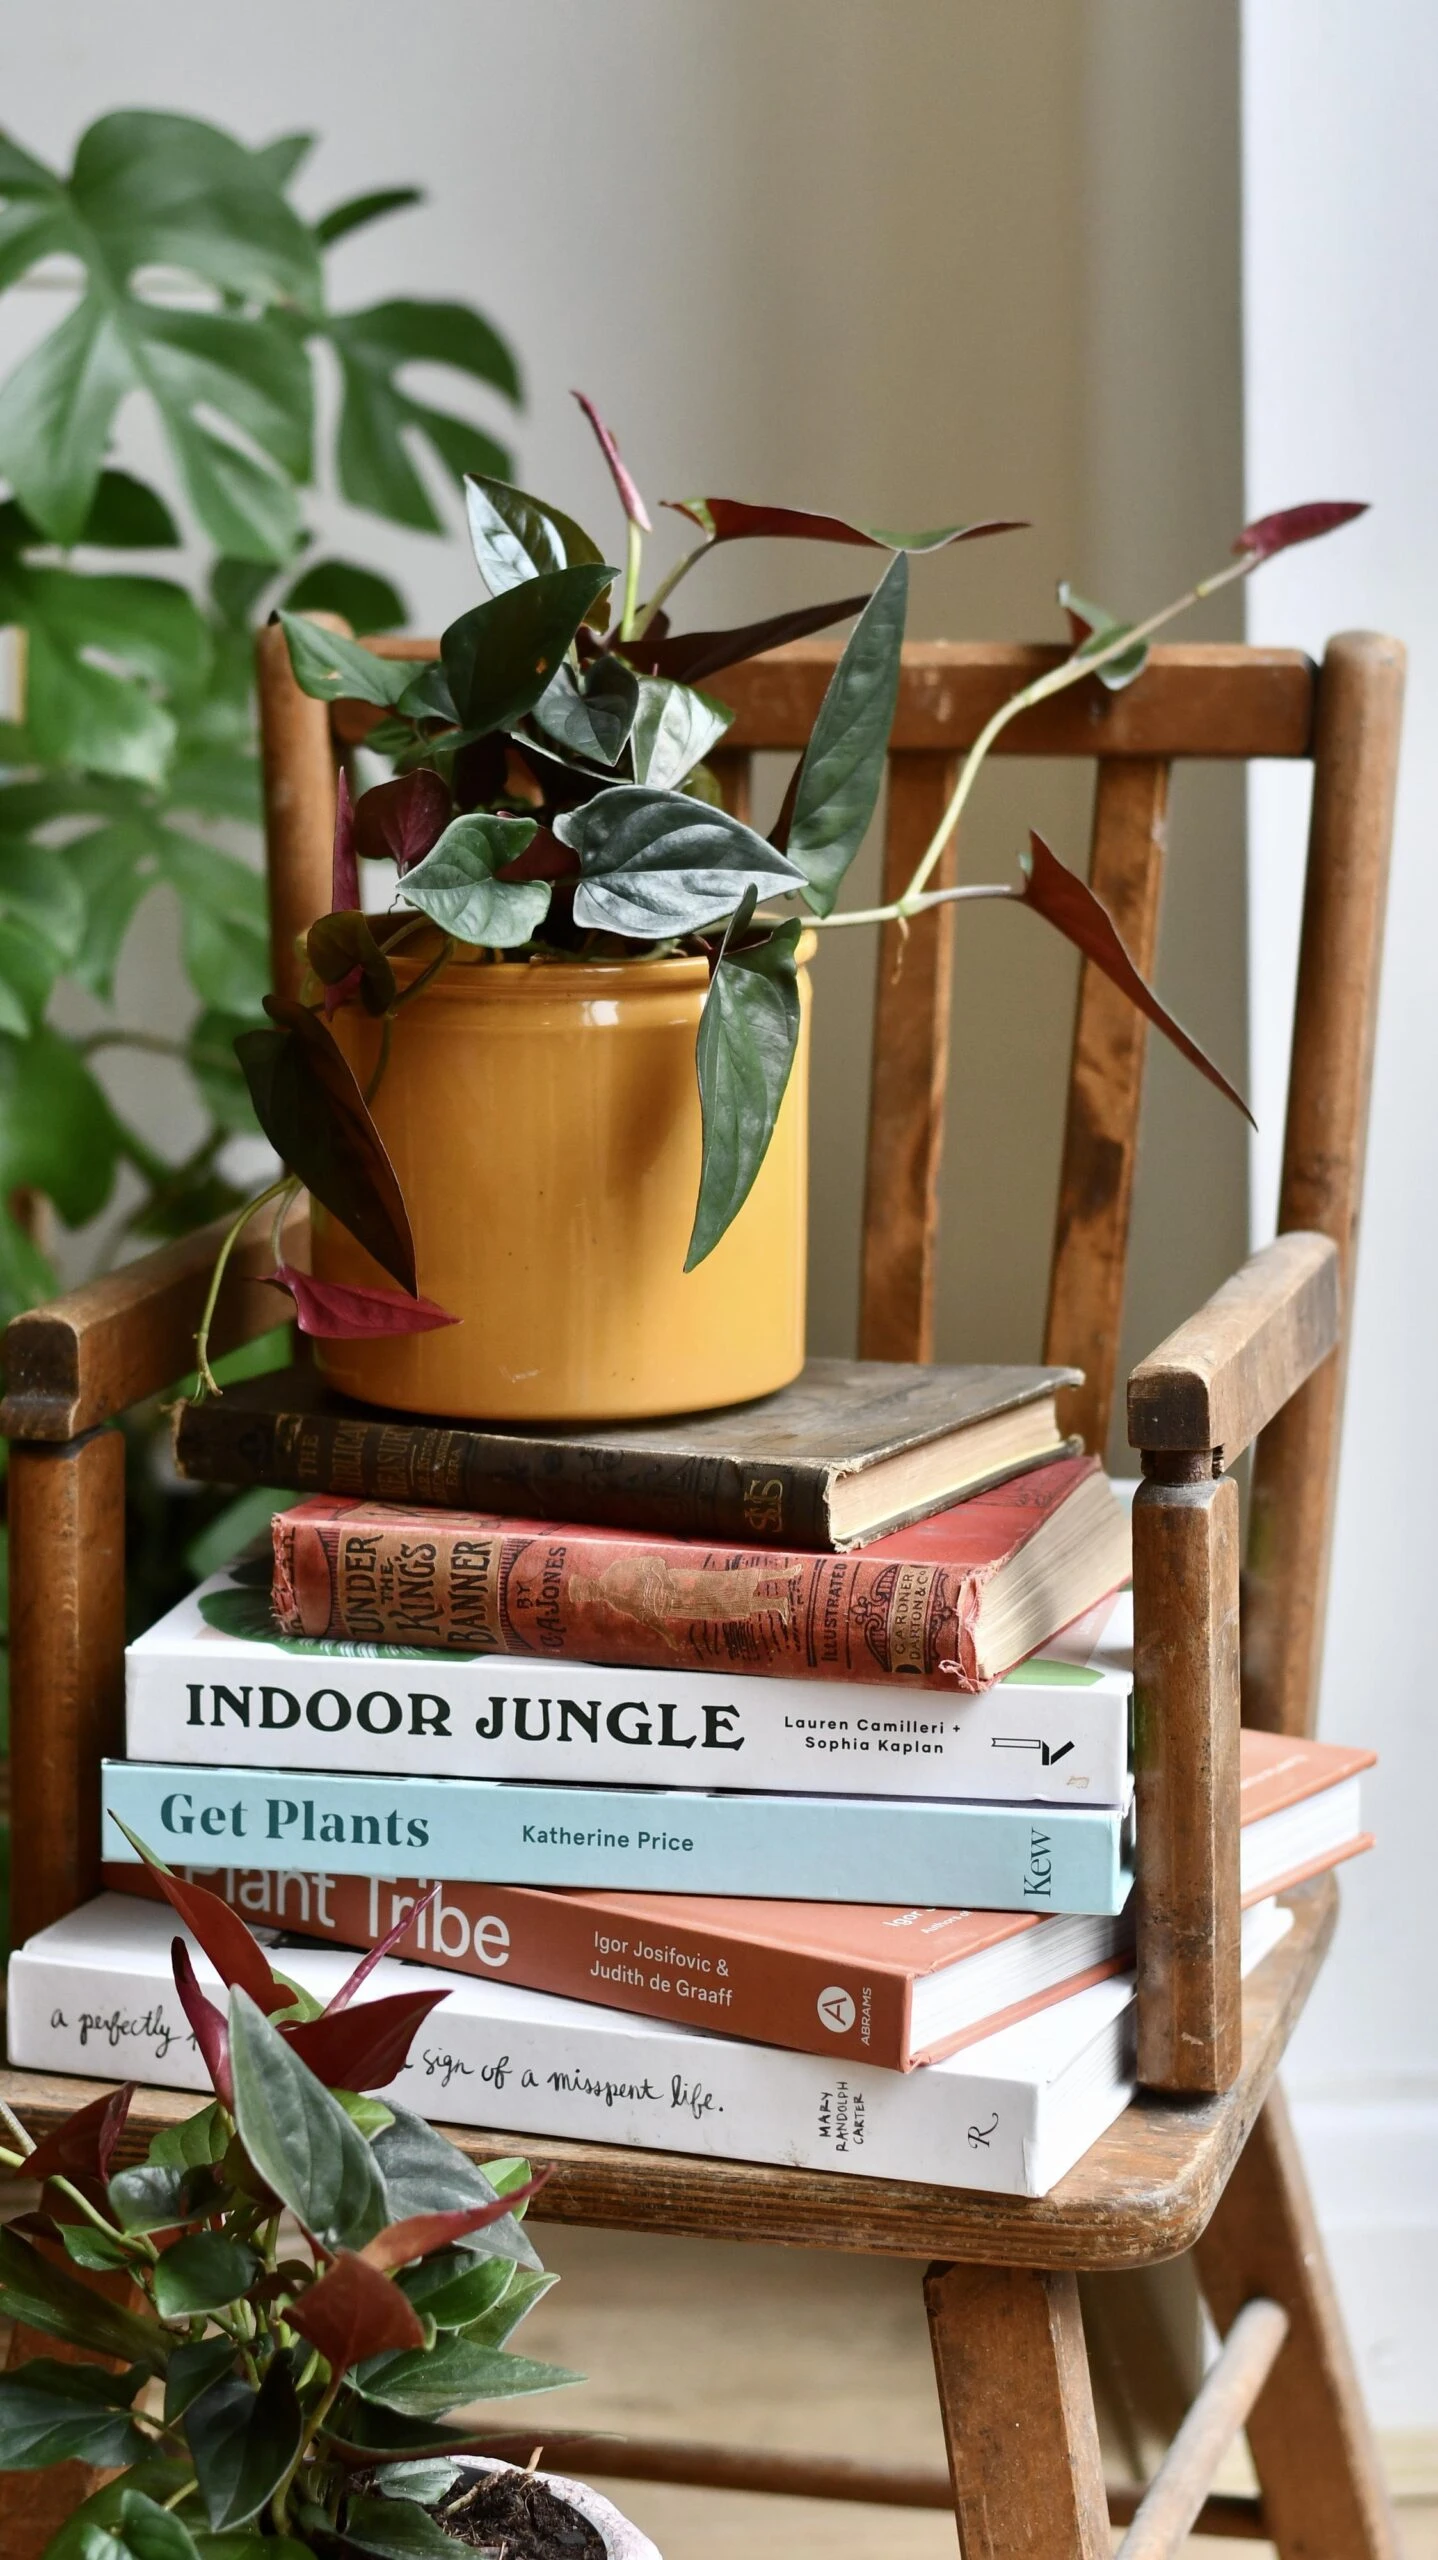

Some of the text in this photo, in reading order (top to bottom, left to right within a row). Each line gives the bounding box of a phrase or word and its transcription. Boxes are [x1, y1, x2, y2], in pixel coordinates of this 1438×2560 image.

[345, 1533, 384, 1638] UNDER
[379, 1557, 394, 1605] THE
[388, 1543, 445, 1635] KING'S
[448, 1539, 498, 1645] BANNER
[516, 1580, 534, 1610] BY
[821, 1562, 848, 1662] ILLUSTRATED
[909, 1601, 926, 1661] DARTON
[186, 1684, 745, 1751] INDOOR JUNGLE
[784, 1716, 961, 1734] Lauren Camilleri +
[805, 1736, 944, 1755] Sophia Kaplan
[160, 1793, 430, 1847] Get Plants
[522, 1824, 694, 1852] Katherine Price
[1023, 1826, 1051, 1898] Kew
[358, 1875, 511, 1968] Tribe
[590, 1960, 733, 2006] Judith de Graaff
[594, 1930, 729, 1977] Igor Josifovic &
[861, 1986, 873, 2046] ABRAMS
[51, 2008, 68, 2028] a
[79, 2004, 181, 2059] perfectly
[422, 2047, 474, 2087] sign
[481, 2055, 512, 2089] of
[521, 2068, 539, 2087] a
[547, 2068, 664, 2107] misspent
[671, 2073, 724, 2119] life.
[818, 2091, 833, 2137] MARY
[835, 2081, 850, 2152] RANDOLPH
[853, 2092, 866, 2145] CARTER
